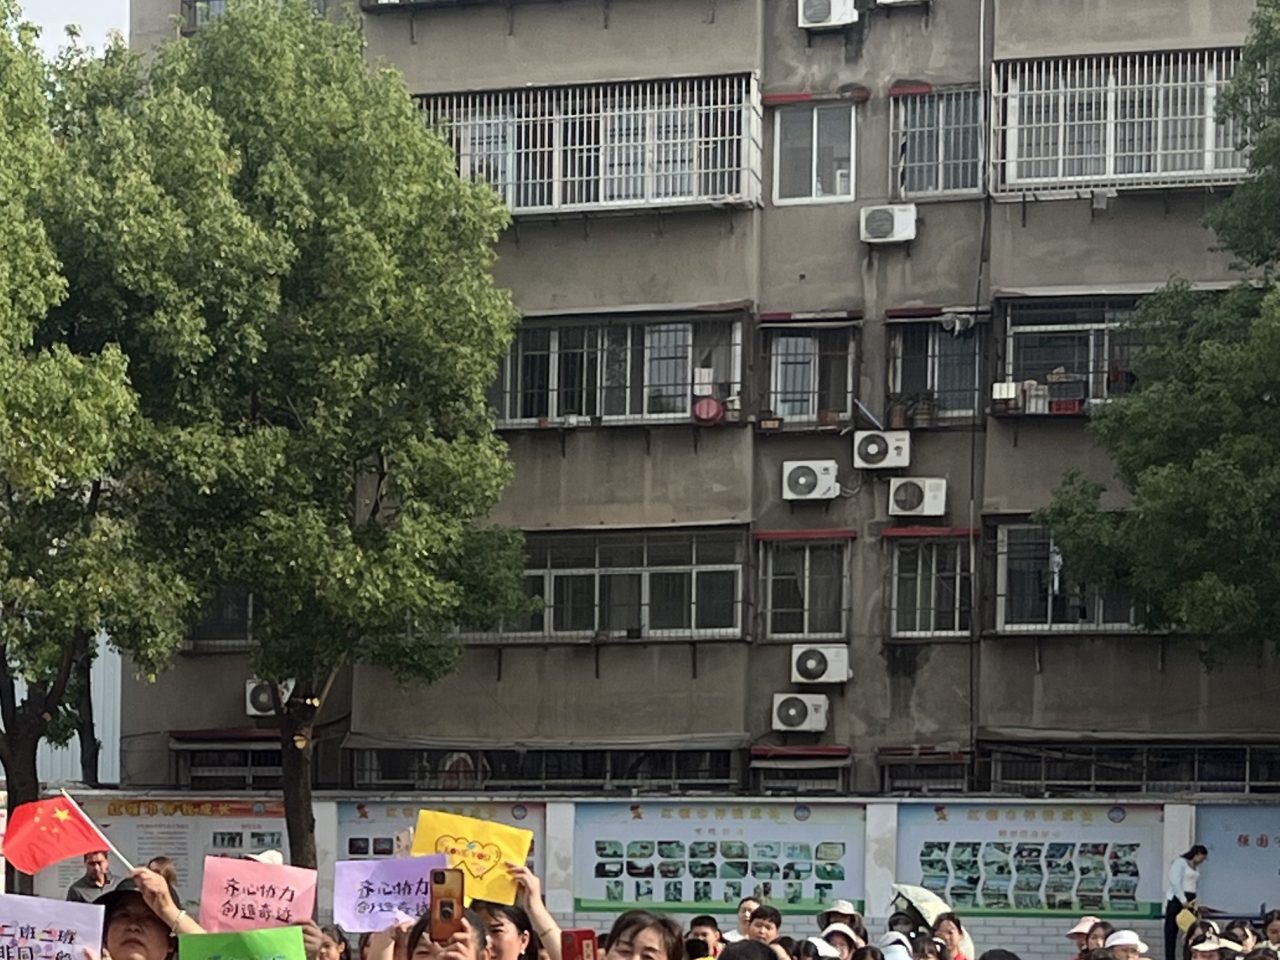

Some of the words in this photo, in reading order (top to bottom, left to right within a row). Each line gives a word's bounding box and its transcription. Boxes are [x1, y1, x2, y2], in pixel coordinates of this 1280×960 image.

[224, 878, 295, 902] 齐心协力
[358, 878, 428, 899] 齐心协力
[221, 900, 293, 924] 创造奇迹
